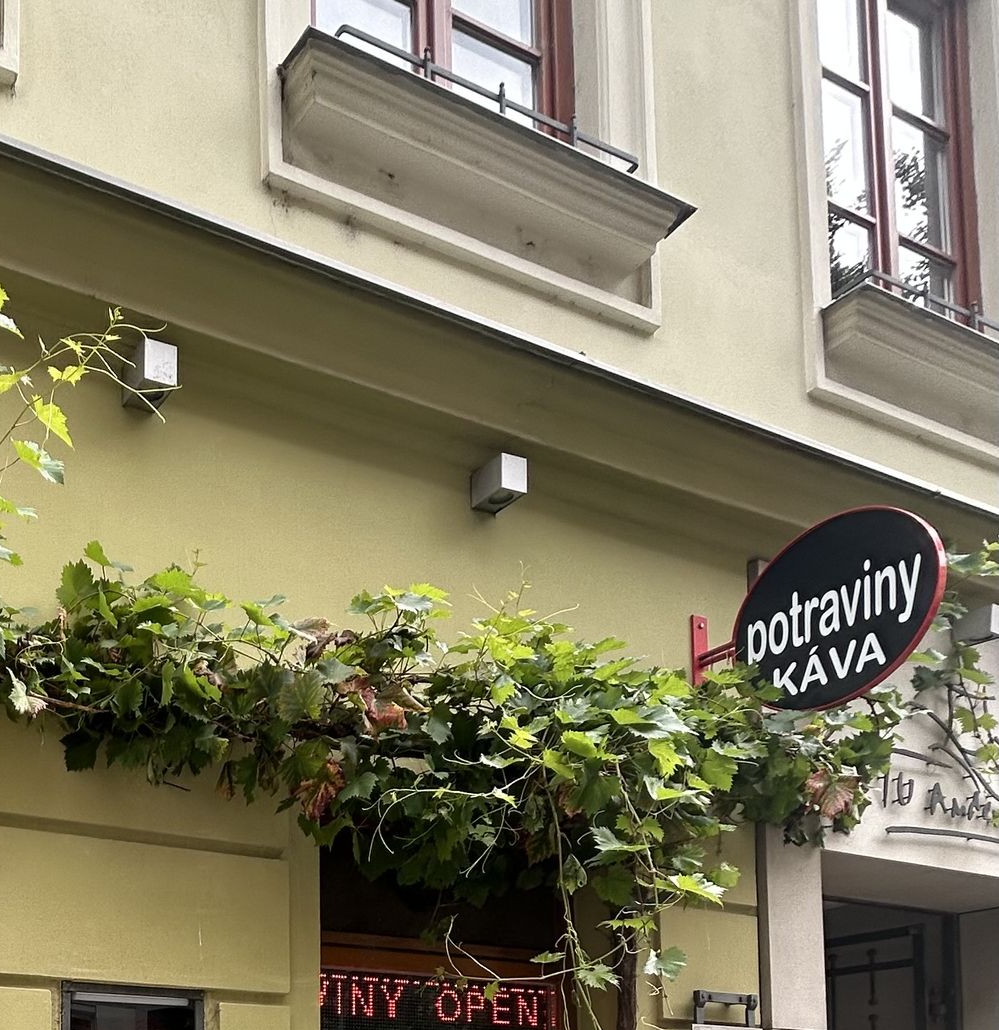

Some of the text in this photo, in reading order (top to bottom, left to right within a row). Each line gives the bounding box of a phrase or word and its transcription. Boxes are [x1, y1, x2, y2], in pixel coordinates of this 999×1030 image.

[747, 553, 921, 665] potraviny
[773, 632, 886, 696] KÁVA
[435, 989, 538, 1026] OPEN
